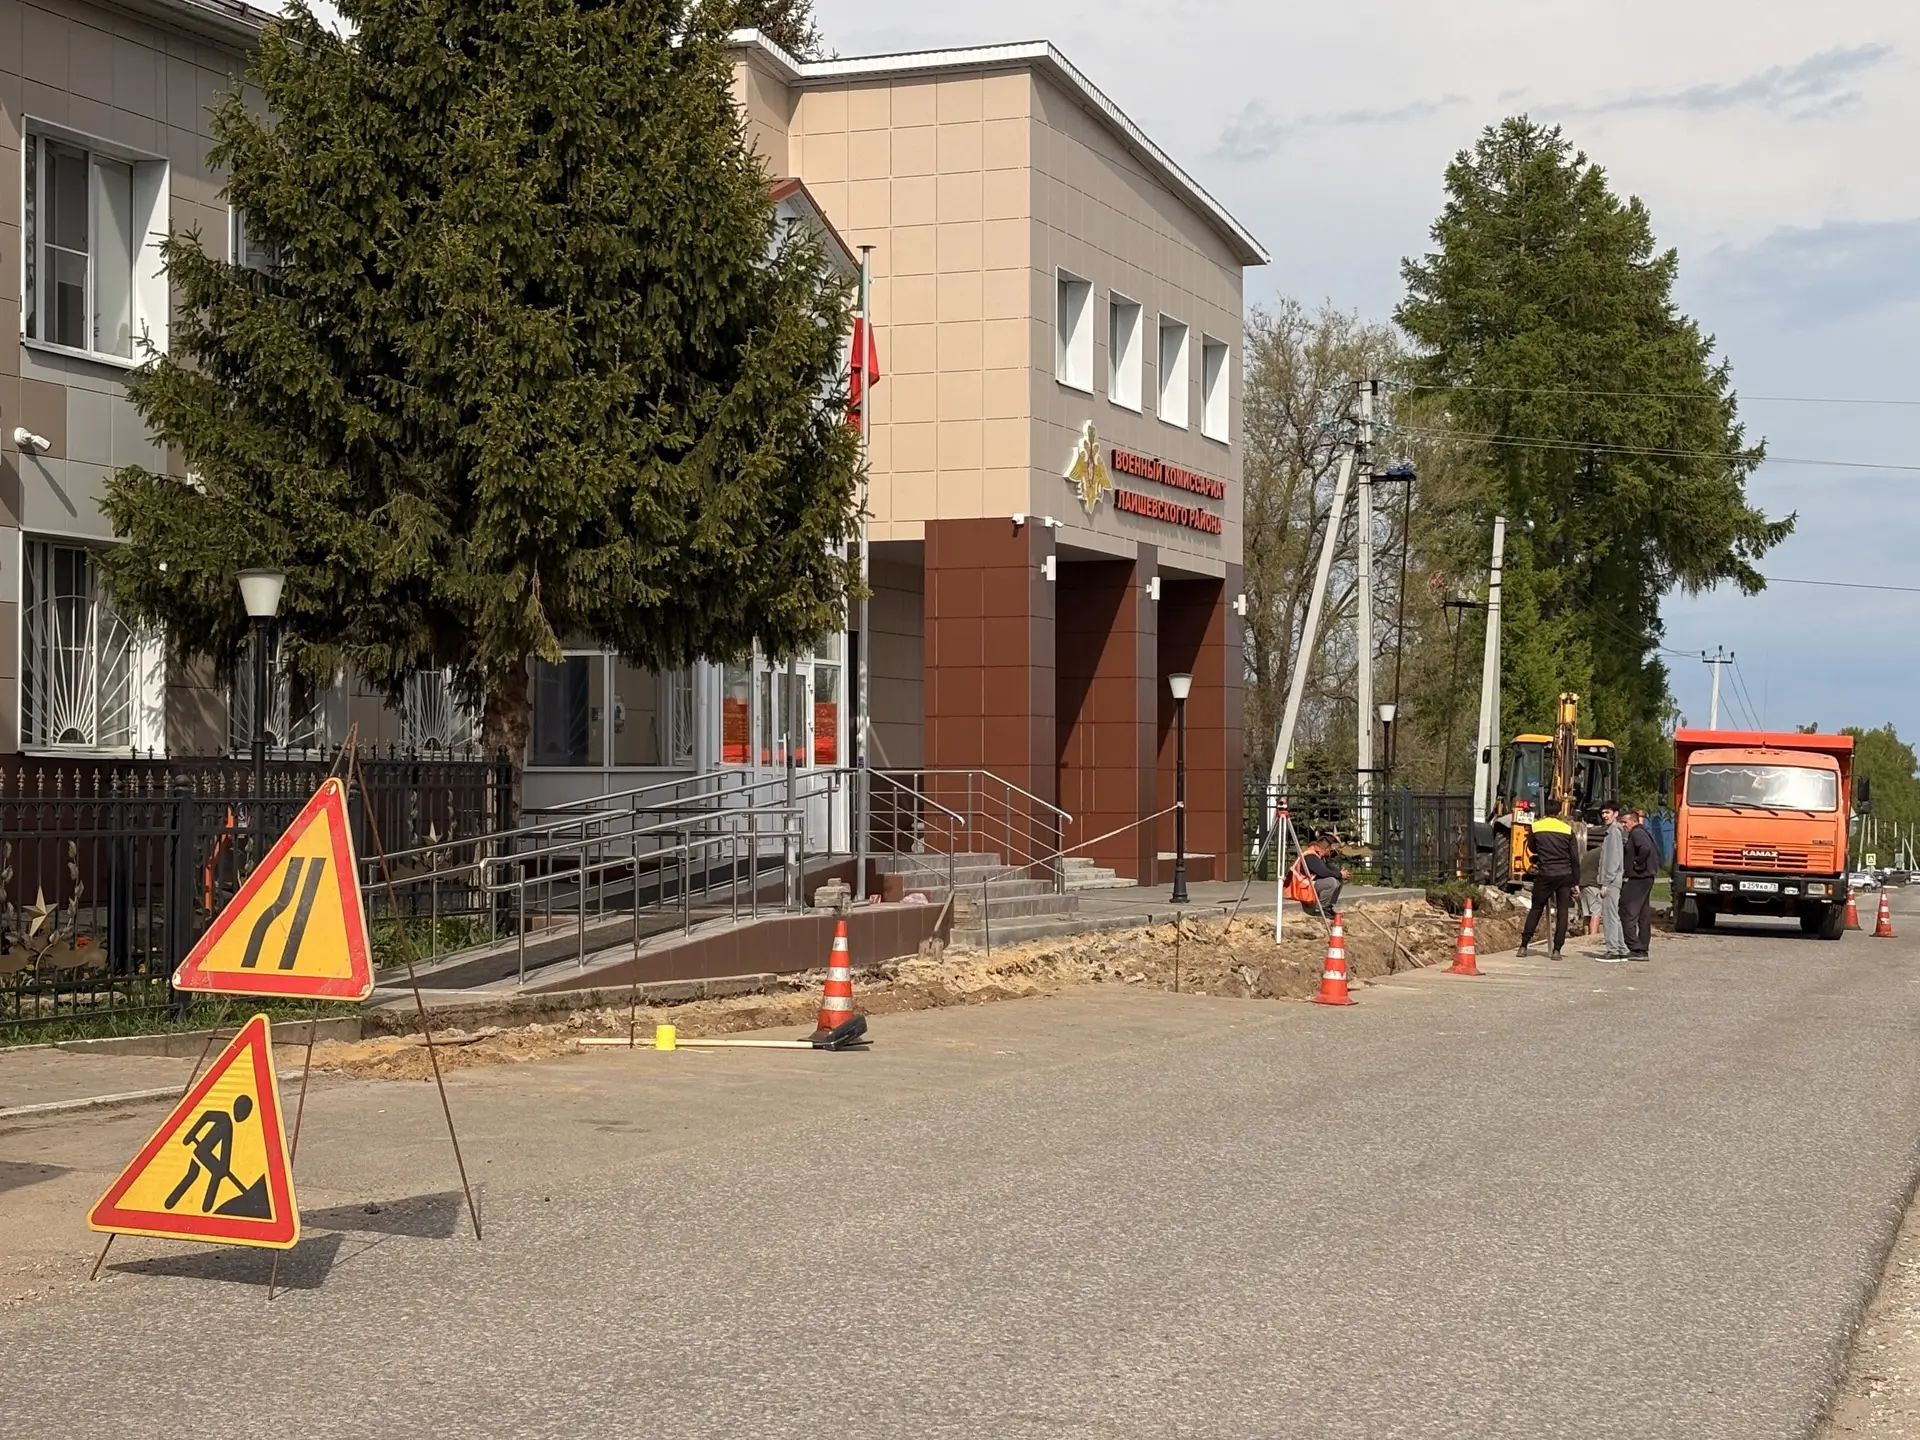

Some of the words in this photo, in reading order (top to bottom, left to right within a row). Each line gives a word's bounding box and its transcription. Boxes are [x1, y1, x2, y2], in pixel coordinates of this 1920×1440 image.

[1114, 450, 1163, 482] ВОЕННЫЙ
[1164, 465, 1227, 500] КОМИССАРИАТ
[1117, 489, 1188, 526] ЛАИШЕВСКОГО
[1189, 507, 1222, 535] РАЙОНА
